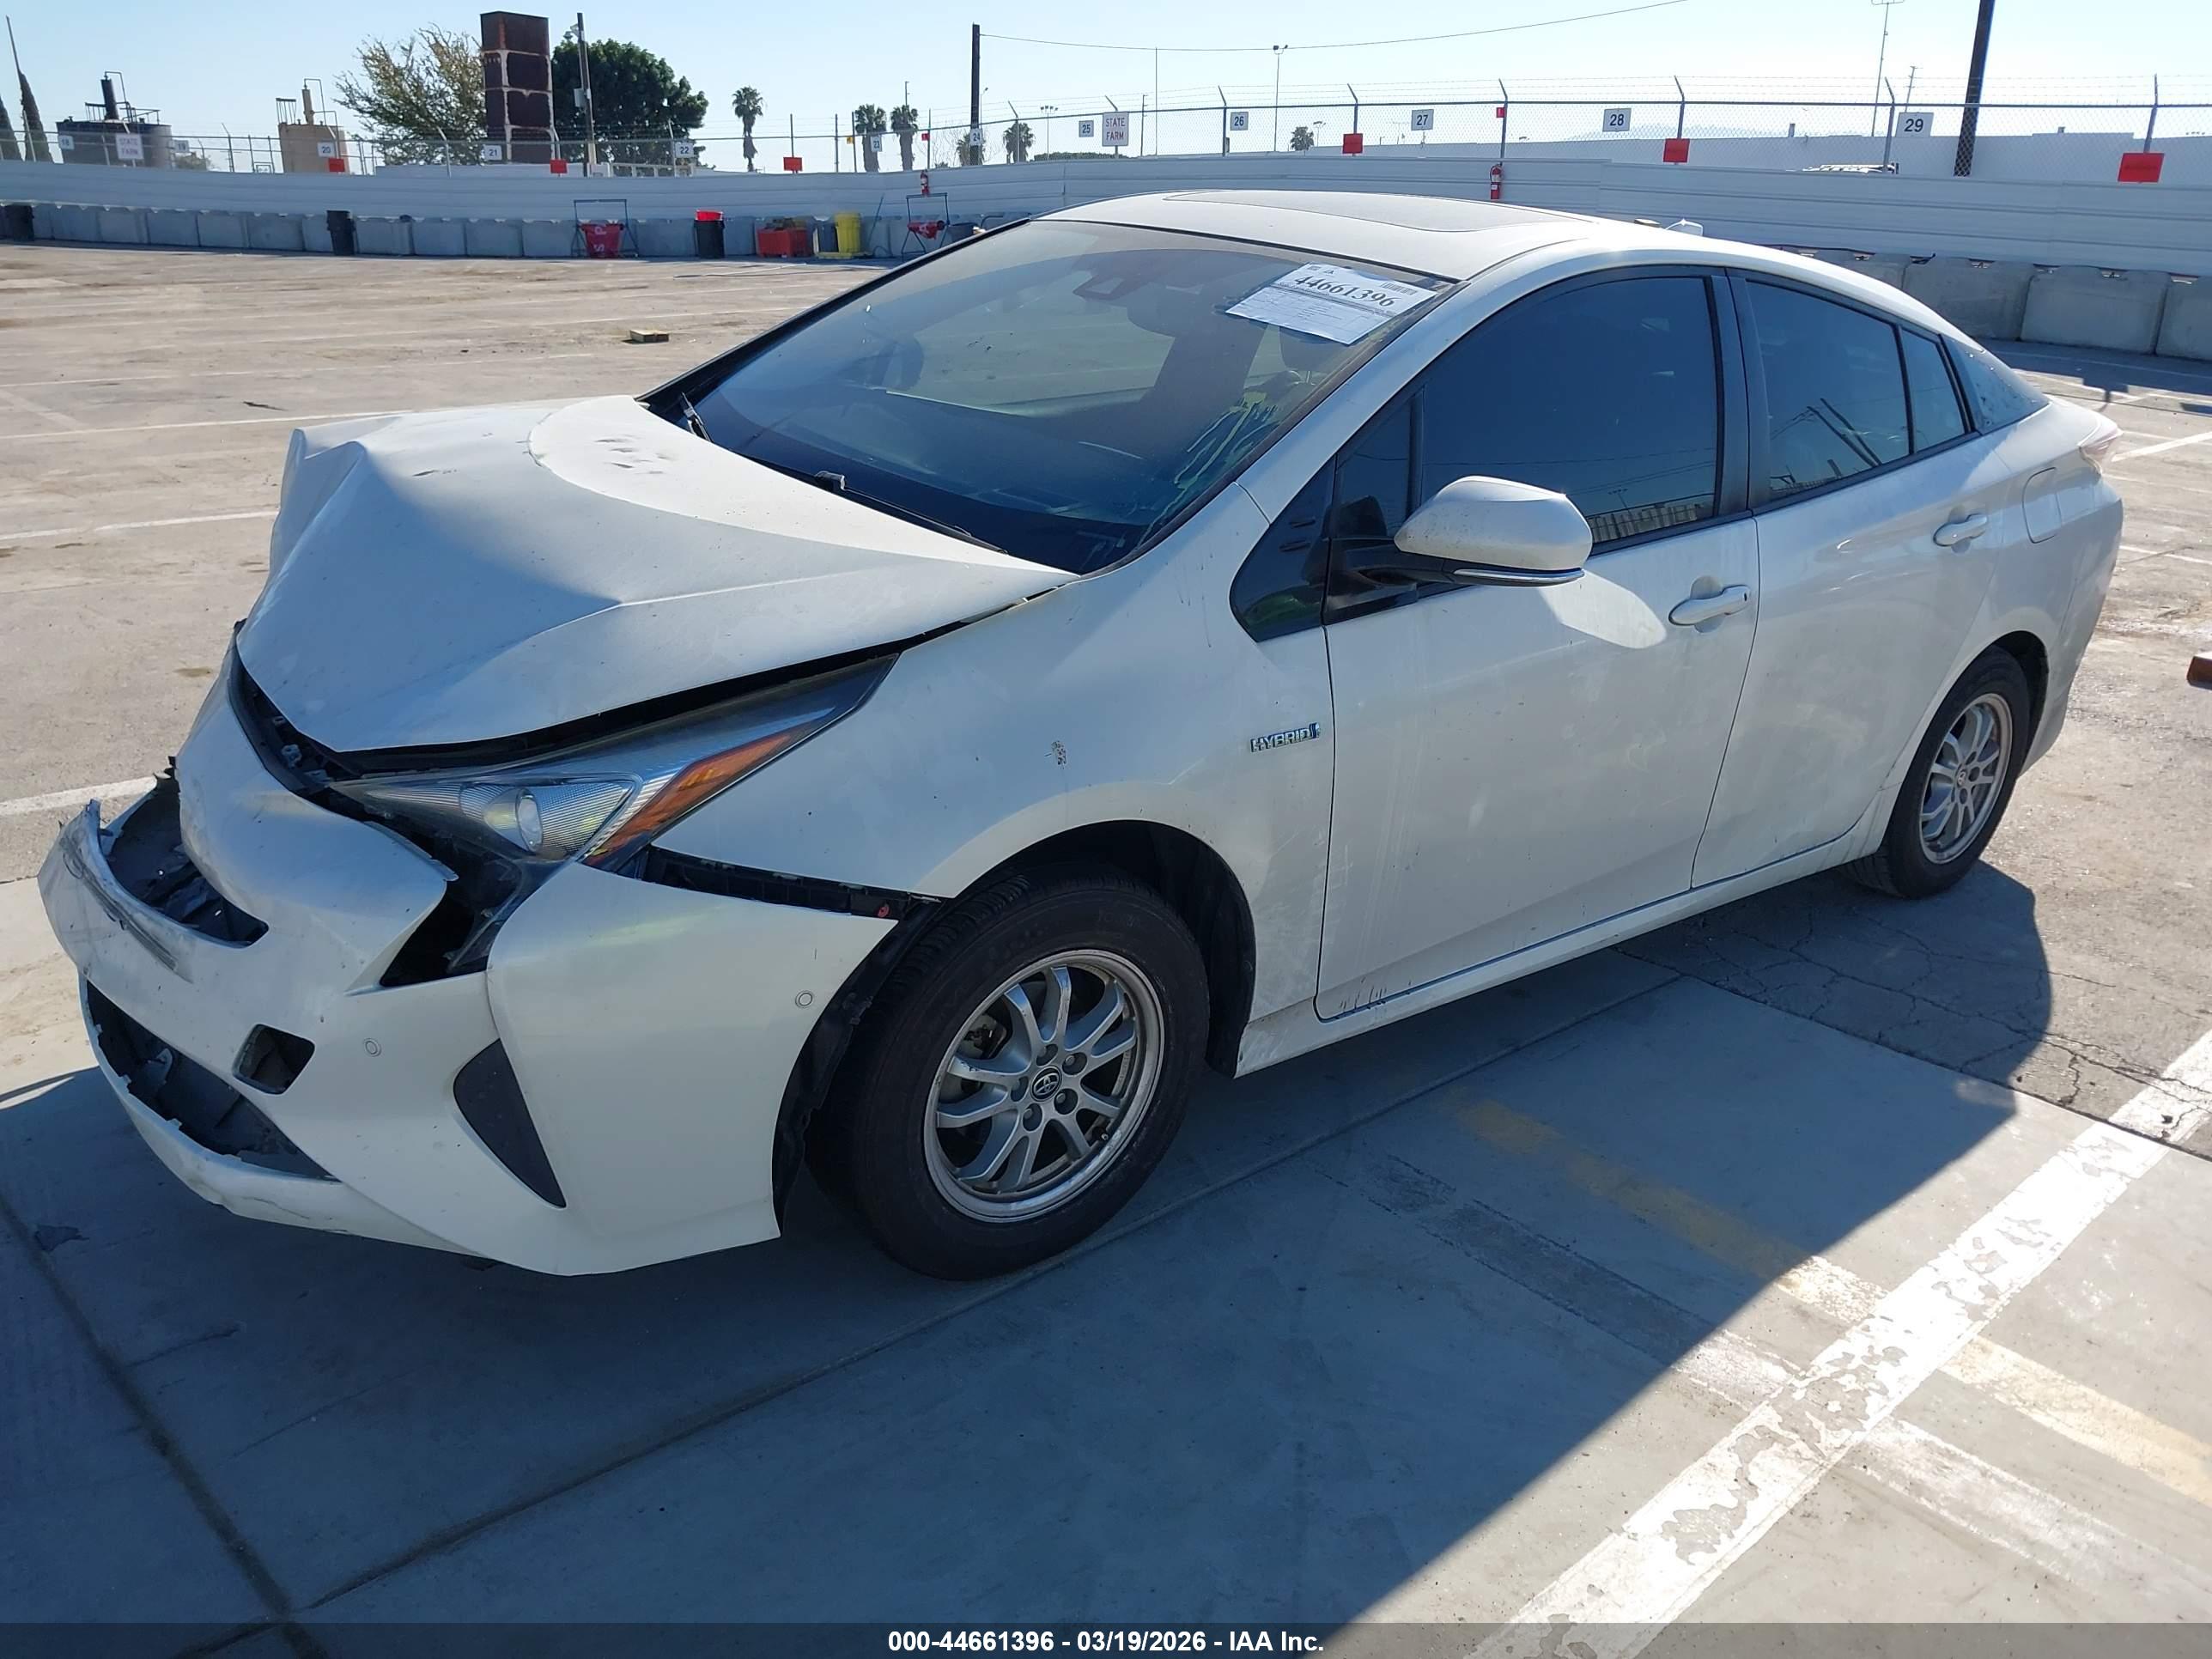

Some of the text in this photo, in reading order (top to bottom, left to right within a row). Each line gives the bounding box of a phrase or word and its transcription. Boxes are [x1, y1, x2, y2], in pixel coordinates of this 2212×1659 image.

[1105, 117, 1126, 127] STATE
[1234, 116, 1244, 126] 26
[1416, 114, 1429, 126] 27
[1609, 113, 1625, 126] 28
[1082, 124, 1091, 134] 25
[1903, 118, 1924, 132] 29
[1105, 131, 1124, 141] FARM
[321, 145, 331, 155] 20
[489, 148, 498, 156] 21
[679, 146, 690, 155] 22
[1294, 275, 1403, 307] 44661396
[1250, 726, 1310, 753] HYBRID
